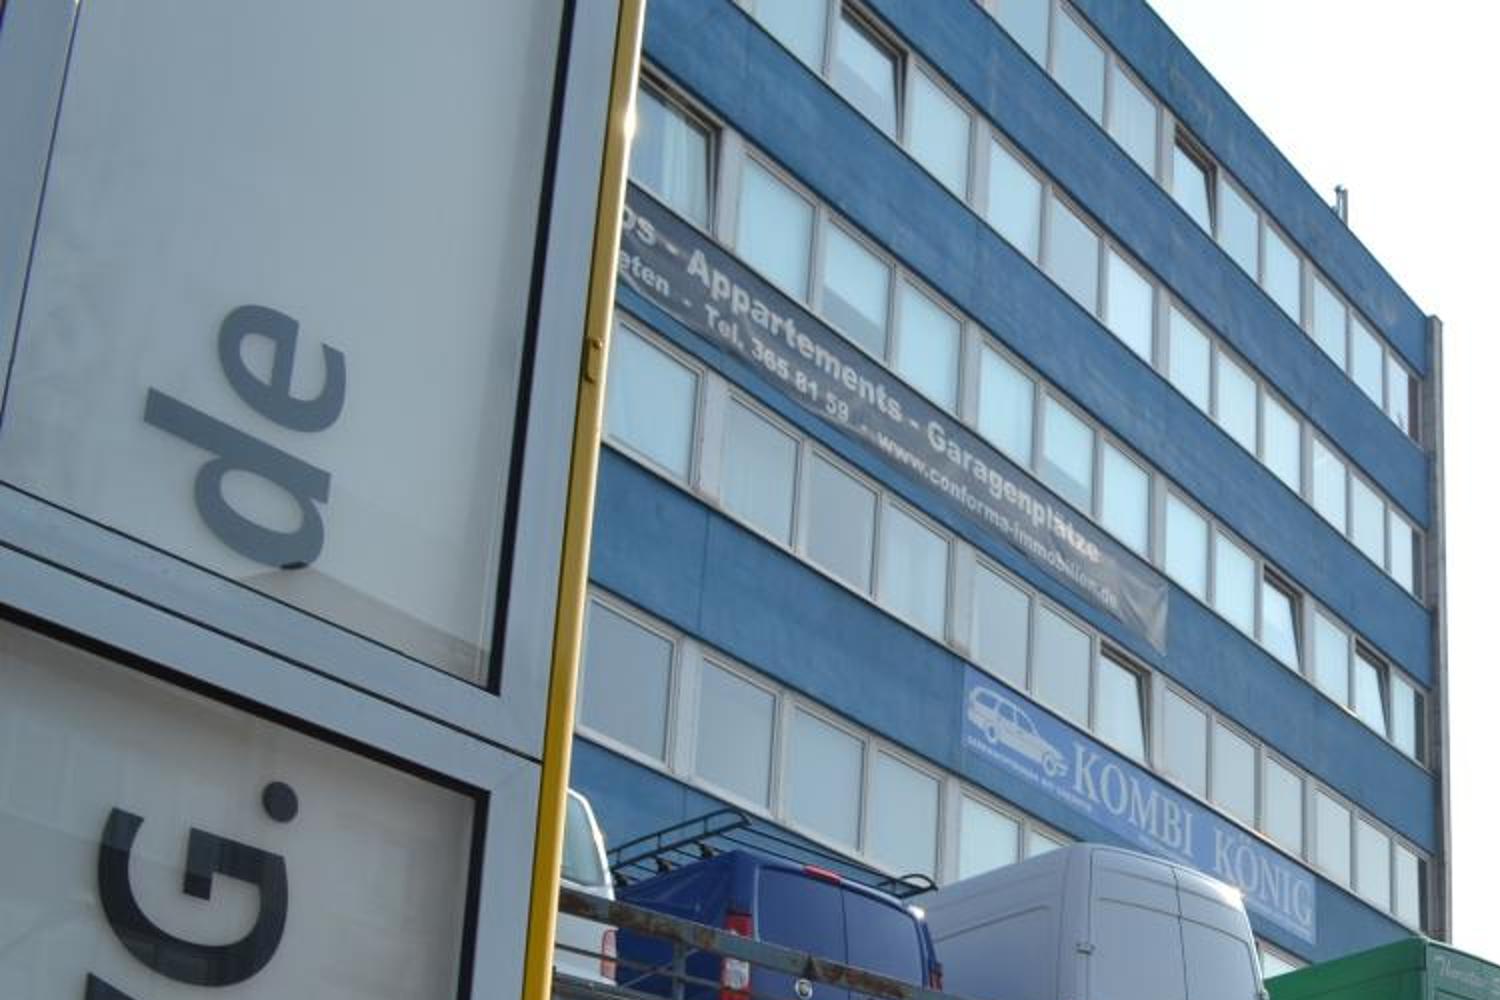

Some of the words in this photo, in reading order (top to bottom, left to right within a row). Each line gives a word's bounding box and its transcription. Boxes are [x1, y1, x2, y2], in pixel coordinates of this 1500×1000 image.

[687, 249, 903, 423] Appartements
[143, 303, 347, 570] de
[1073, 741, 1195, 860] KOMBI
